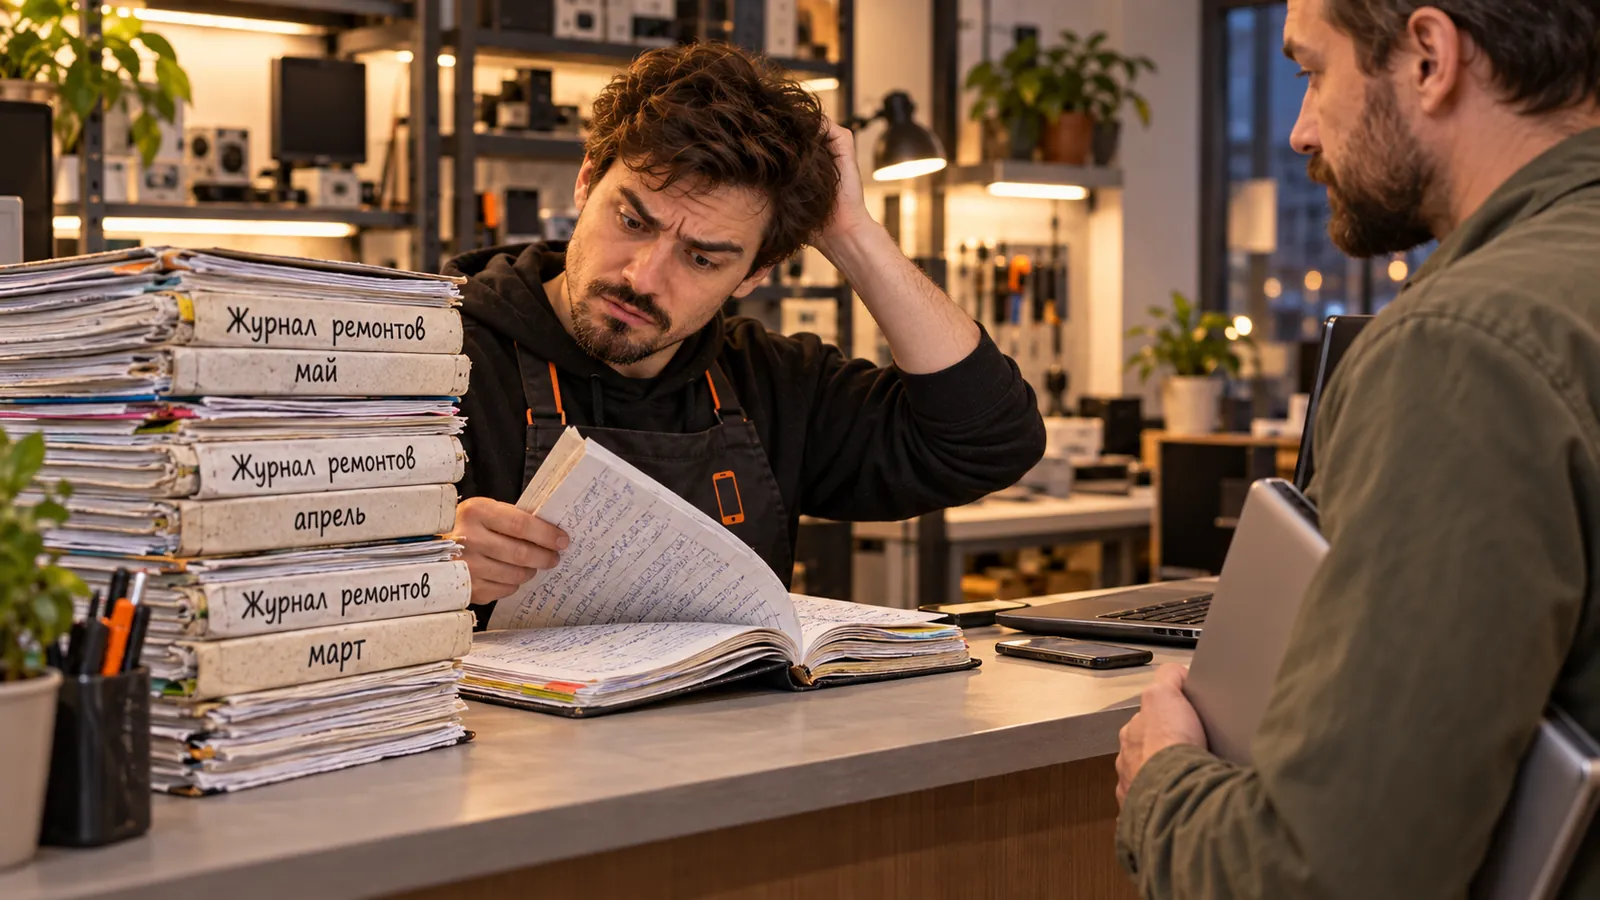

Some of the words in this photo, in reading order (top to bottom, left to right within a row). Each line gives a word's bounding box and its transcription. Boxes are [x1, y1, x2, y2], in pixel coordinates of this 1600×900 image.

[225, 306, 318, 345] Журнал
[332, 315, 426, 347] ремонтов
[294, 356, 338, 384] май
[231, 453, 316, 489] Журнал
[327, 445, 416, 484] ремонтов
[294, 507, 366, 538] апрель
[241, 590, 328, 625] Журнал
[341, 572, 431, 616] ремонтов
[307, 638, 367, 673] март
